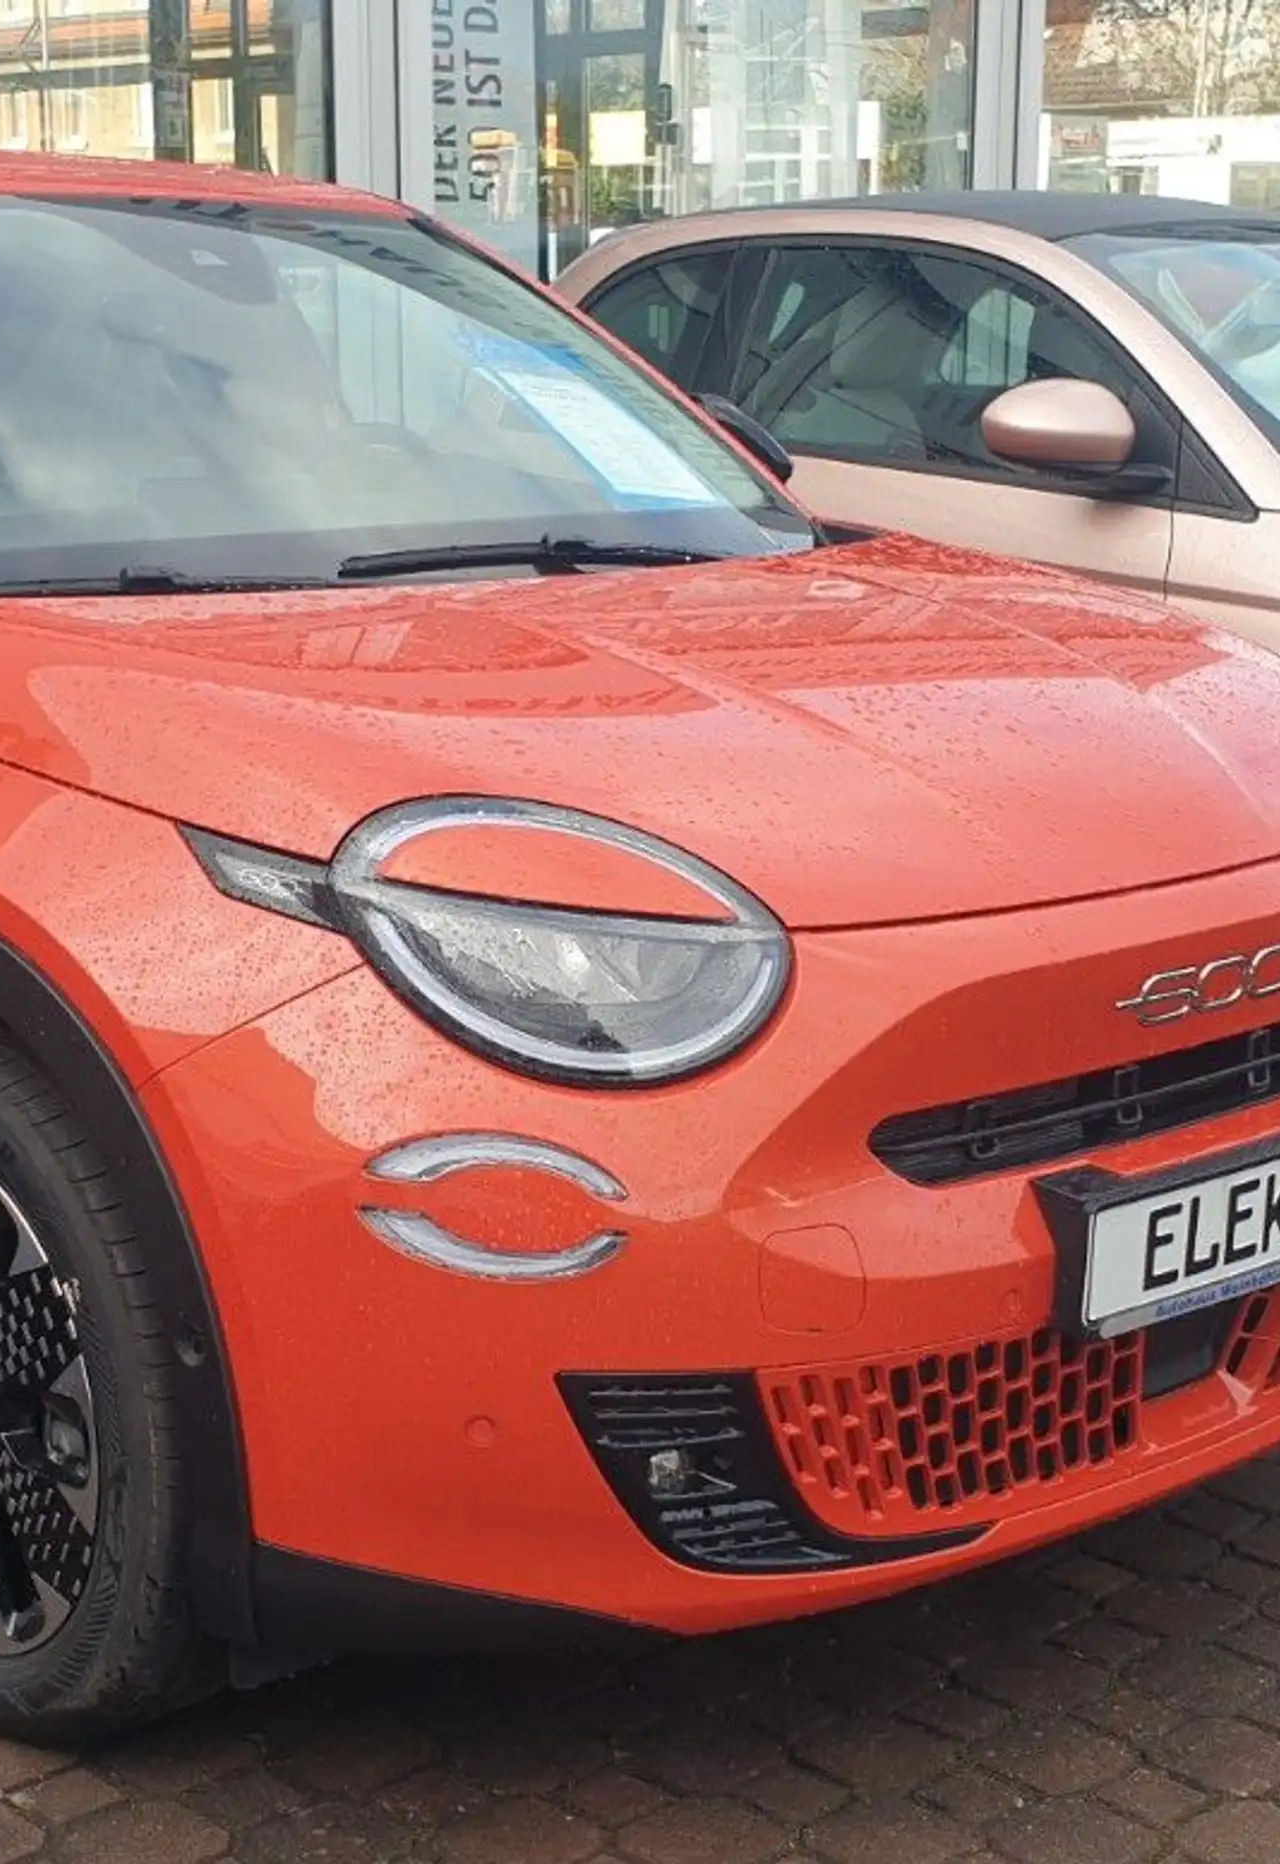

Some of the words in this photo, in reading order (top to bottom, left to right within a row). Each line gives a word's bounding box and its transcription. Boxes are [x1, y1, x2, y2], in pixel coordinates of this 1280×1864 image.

[463, 0, 500, 34] D
[464, 49, 502, 107] IST
[433, 124, 460, 203] DER
